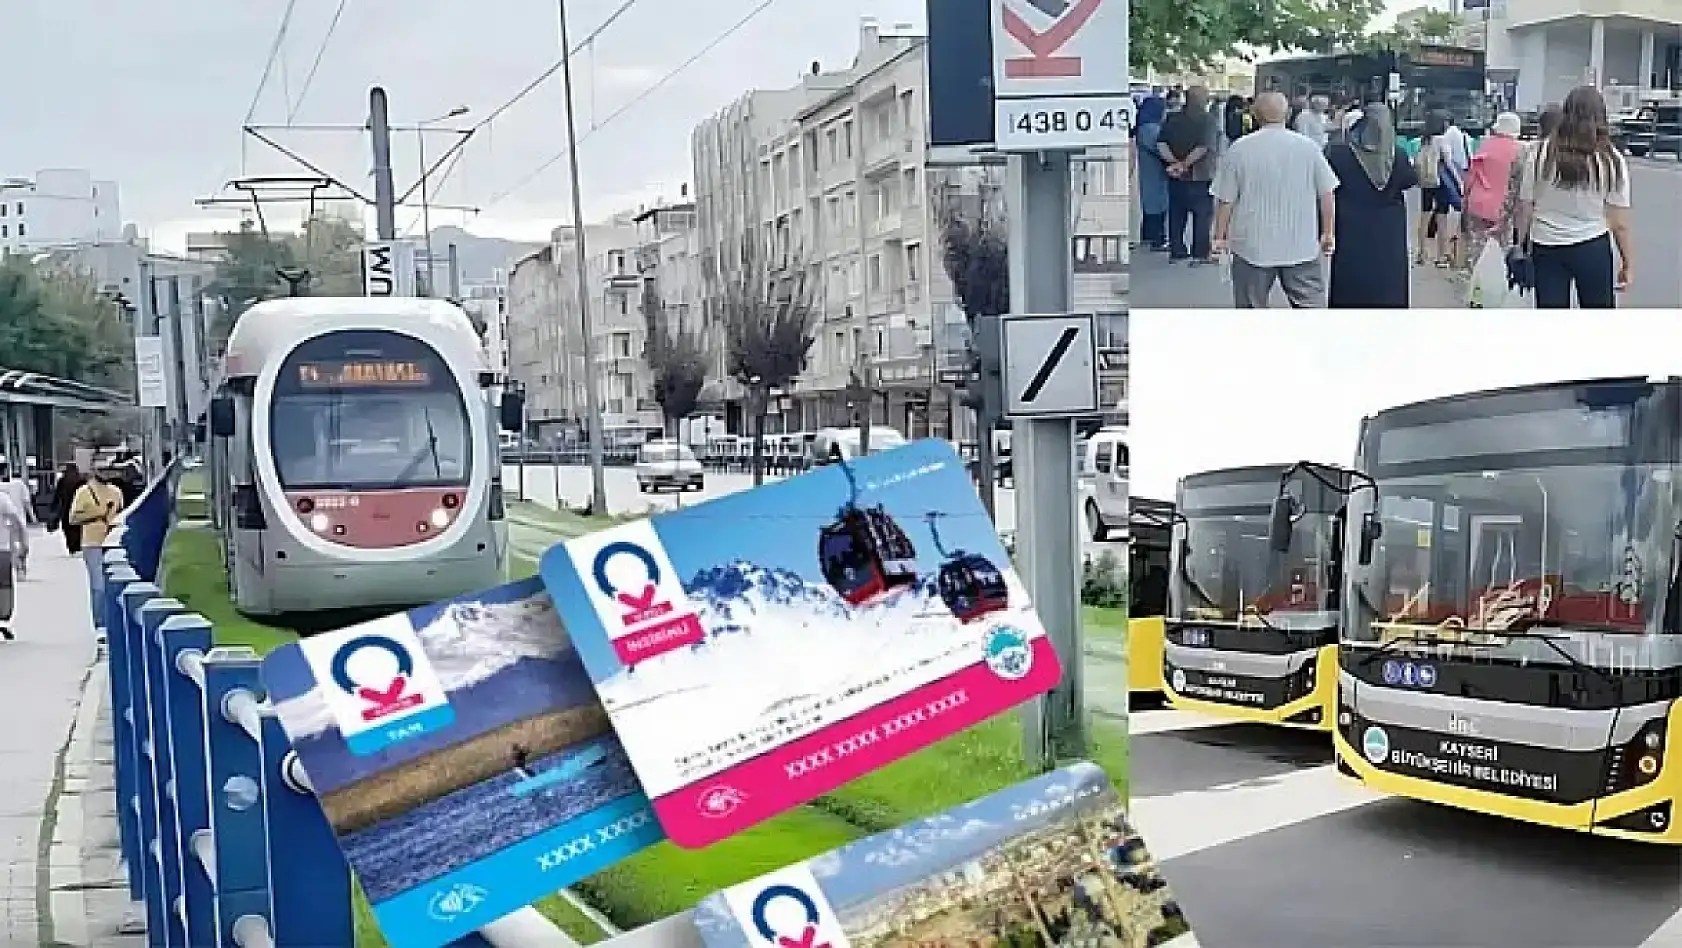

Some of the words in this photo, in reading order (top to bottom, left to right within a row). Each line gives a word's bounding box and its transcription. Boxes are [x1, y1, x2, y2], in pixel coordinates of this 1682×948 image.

[784, 744, 834, 780] XXXX
[834, 724, 881, 758] XXXX
[880, 706, 931, 738] XXXX
[925, 687, 970, 716] XXXX
[535, 832, 596, 873] XXXX
